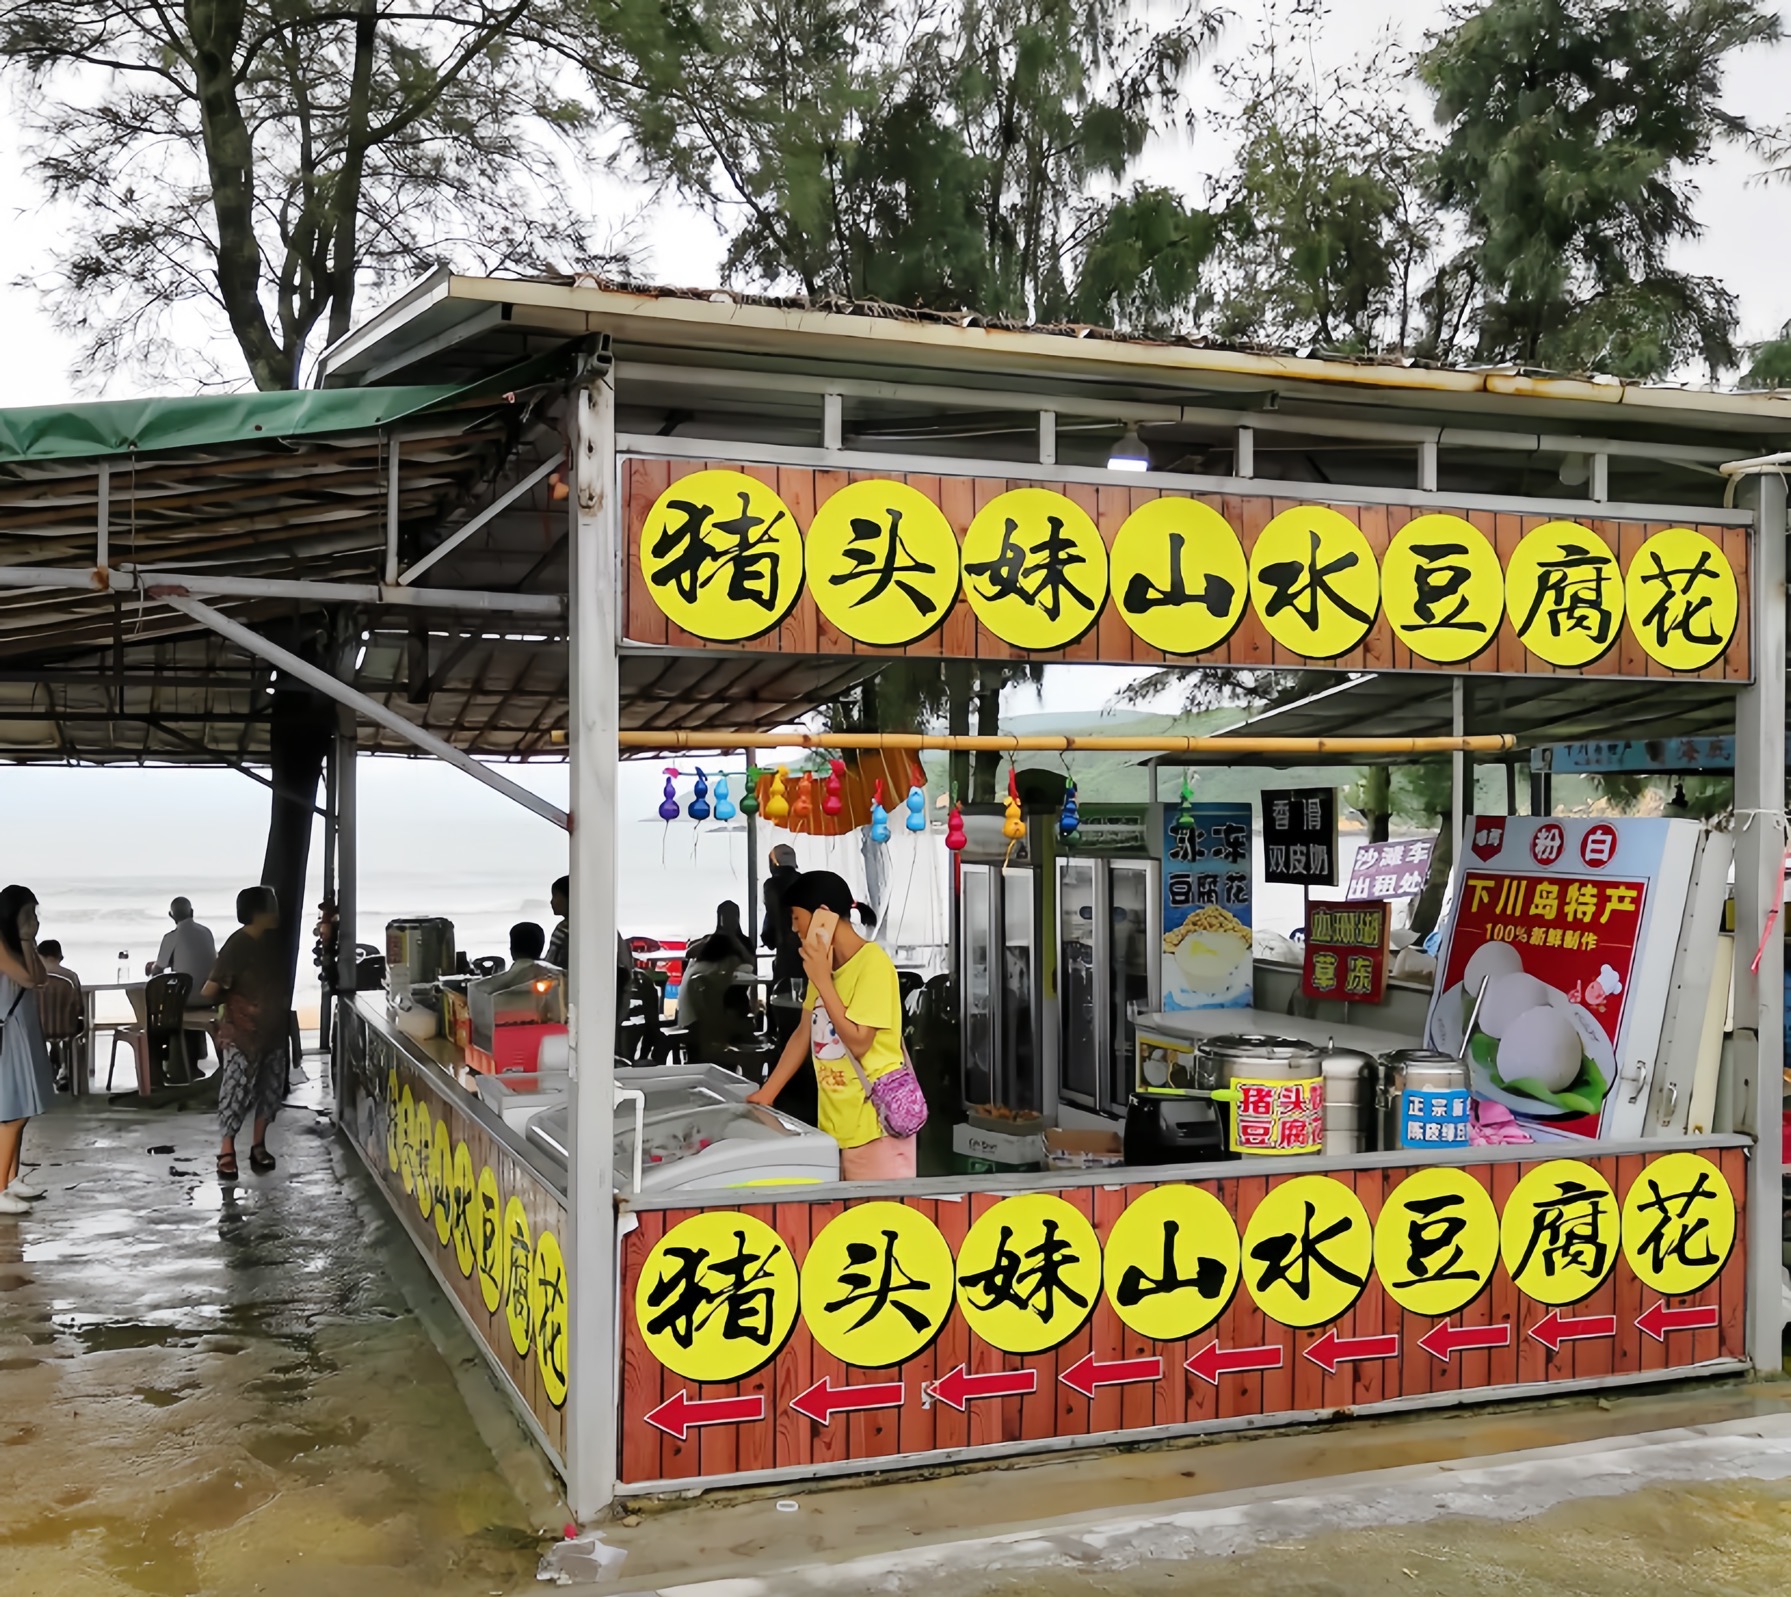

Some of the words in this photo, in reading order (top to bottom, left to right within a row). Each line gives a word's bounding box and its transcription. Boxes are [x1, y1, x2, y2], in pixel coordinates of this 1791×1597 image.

[650, 491, 1724, 647] 猪头妹山水豆腐花
[1271, 798, 1322, 831] 香滑
[1168, 820, 1247, 864] 冰冻
[1268, 844, 1329, 876] 双皮奶
[1353, 841, 1431, 871] 沙滩车
[1168, 872, 1249, 908] 豆腐花
[1347, 870, 1422, 899] 出租处
[1467, 877, 1638, 924] 下川岛特产
[1484, 922, 1599, 951] 100%新鲜制作
[1312, 951, 1373, 994] 草冻
[646, 1172, 1721, 1349] 猪头妹山水豆腐花
